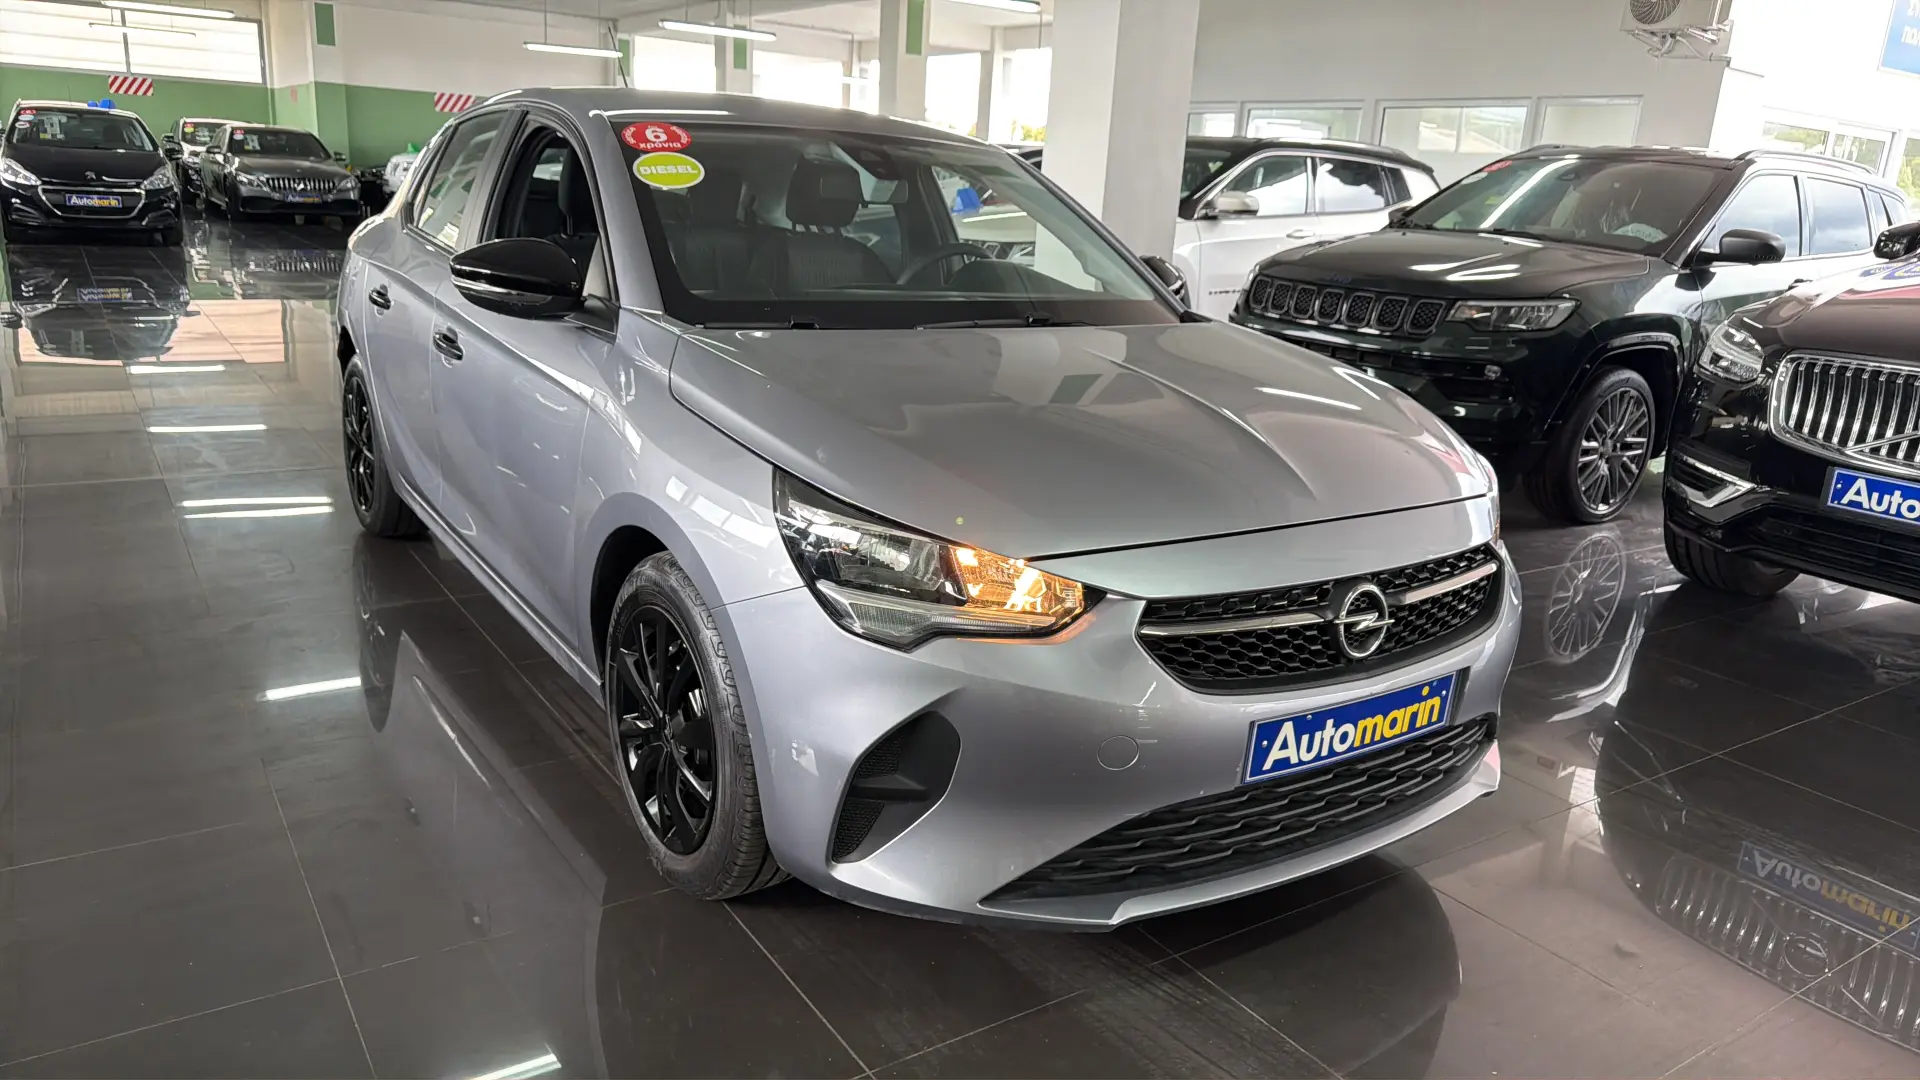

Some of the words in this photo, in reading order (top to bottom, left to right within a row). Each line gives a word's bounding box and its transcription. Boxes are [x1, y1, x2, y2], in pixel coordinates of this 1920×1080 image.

[645, 127, 667, 142] 6
[639, 140, 682, 149] χρόνια
[640, 164, 698, 175] DIESEL
[70, 196, 118, 207] Automarin
[1840, 478, 1920, 519] Auto
[1262, 686, 1441, 771] Automarin
